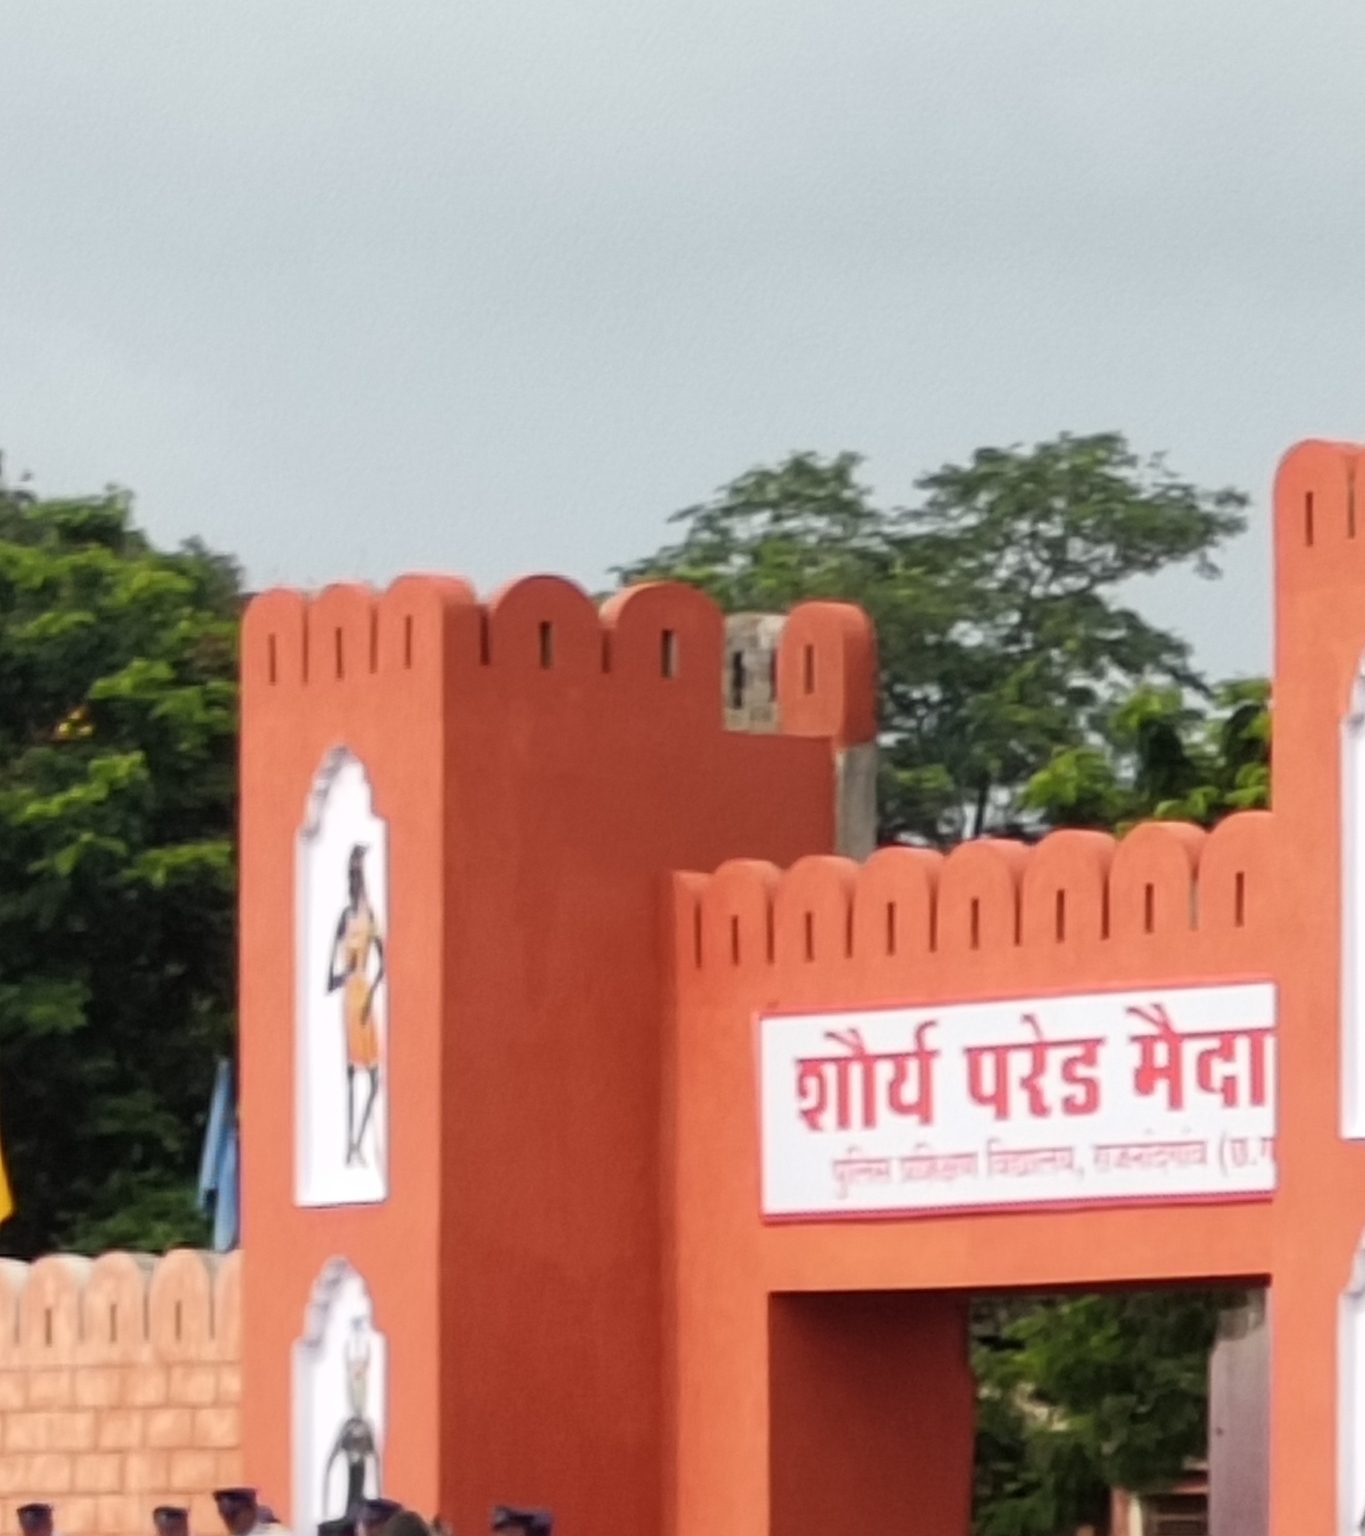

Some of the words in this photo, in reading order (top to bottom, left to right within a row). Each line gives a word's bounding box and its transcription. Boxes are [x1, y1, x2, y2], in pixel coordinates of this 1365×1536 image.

[794, 1020, 940, 1132] शौर्य
[964, 1013, 1106, 1121] परेड
[1126, 1003, 1275, 1111] मैदा
